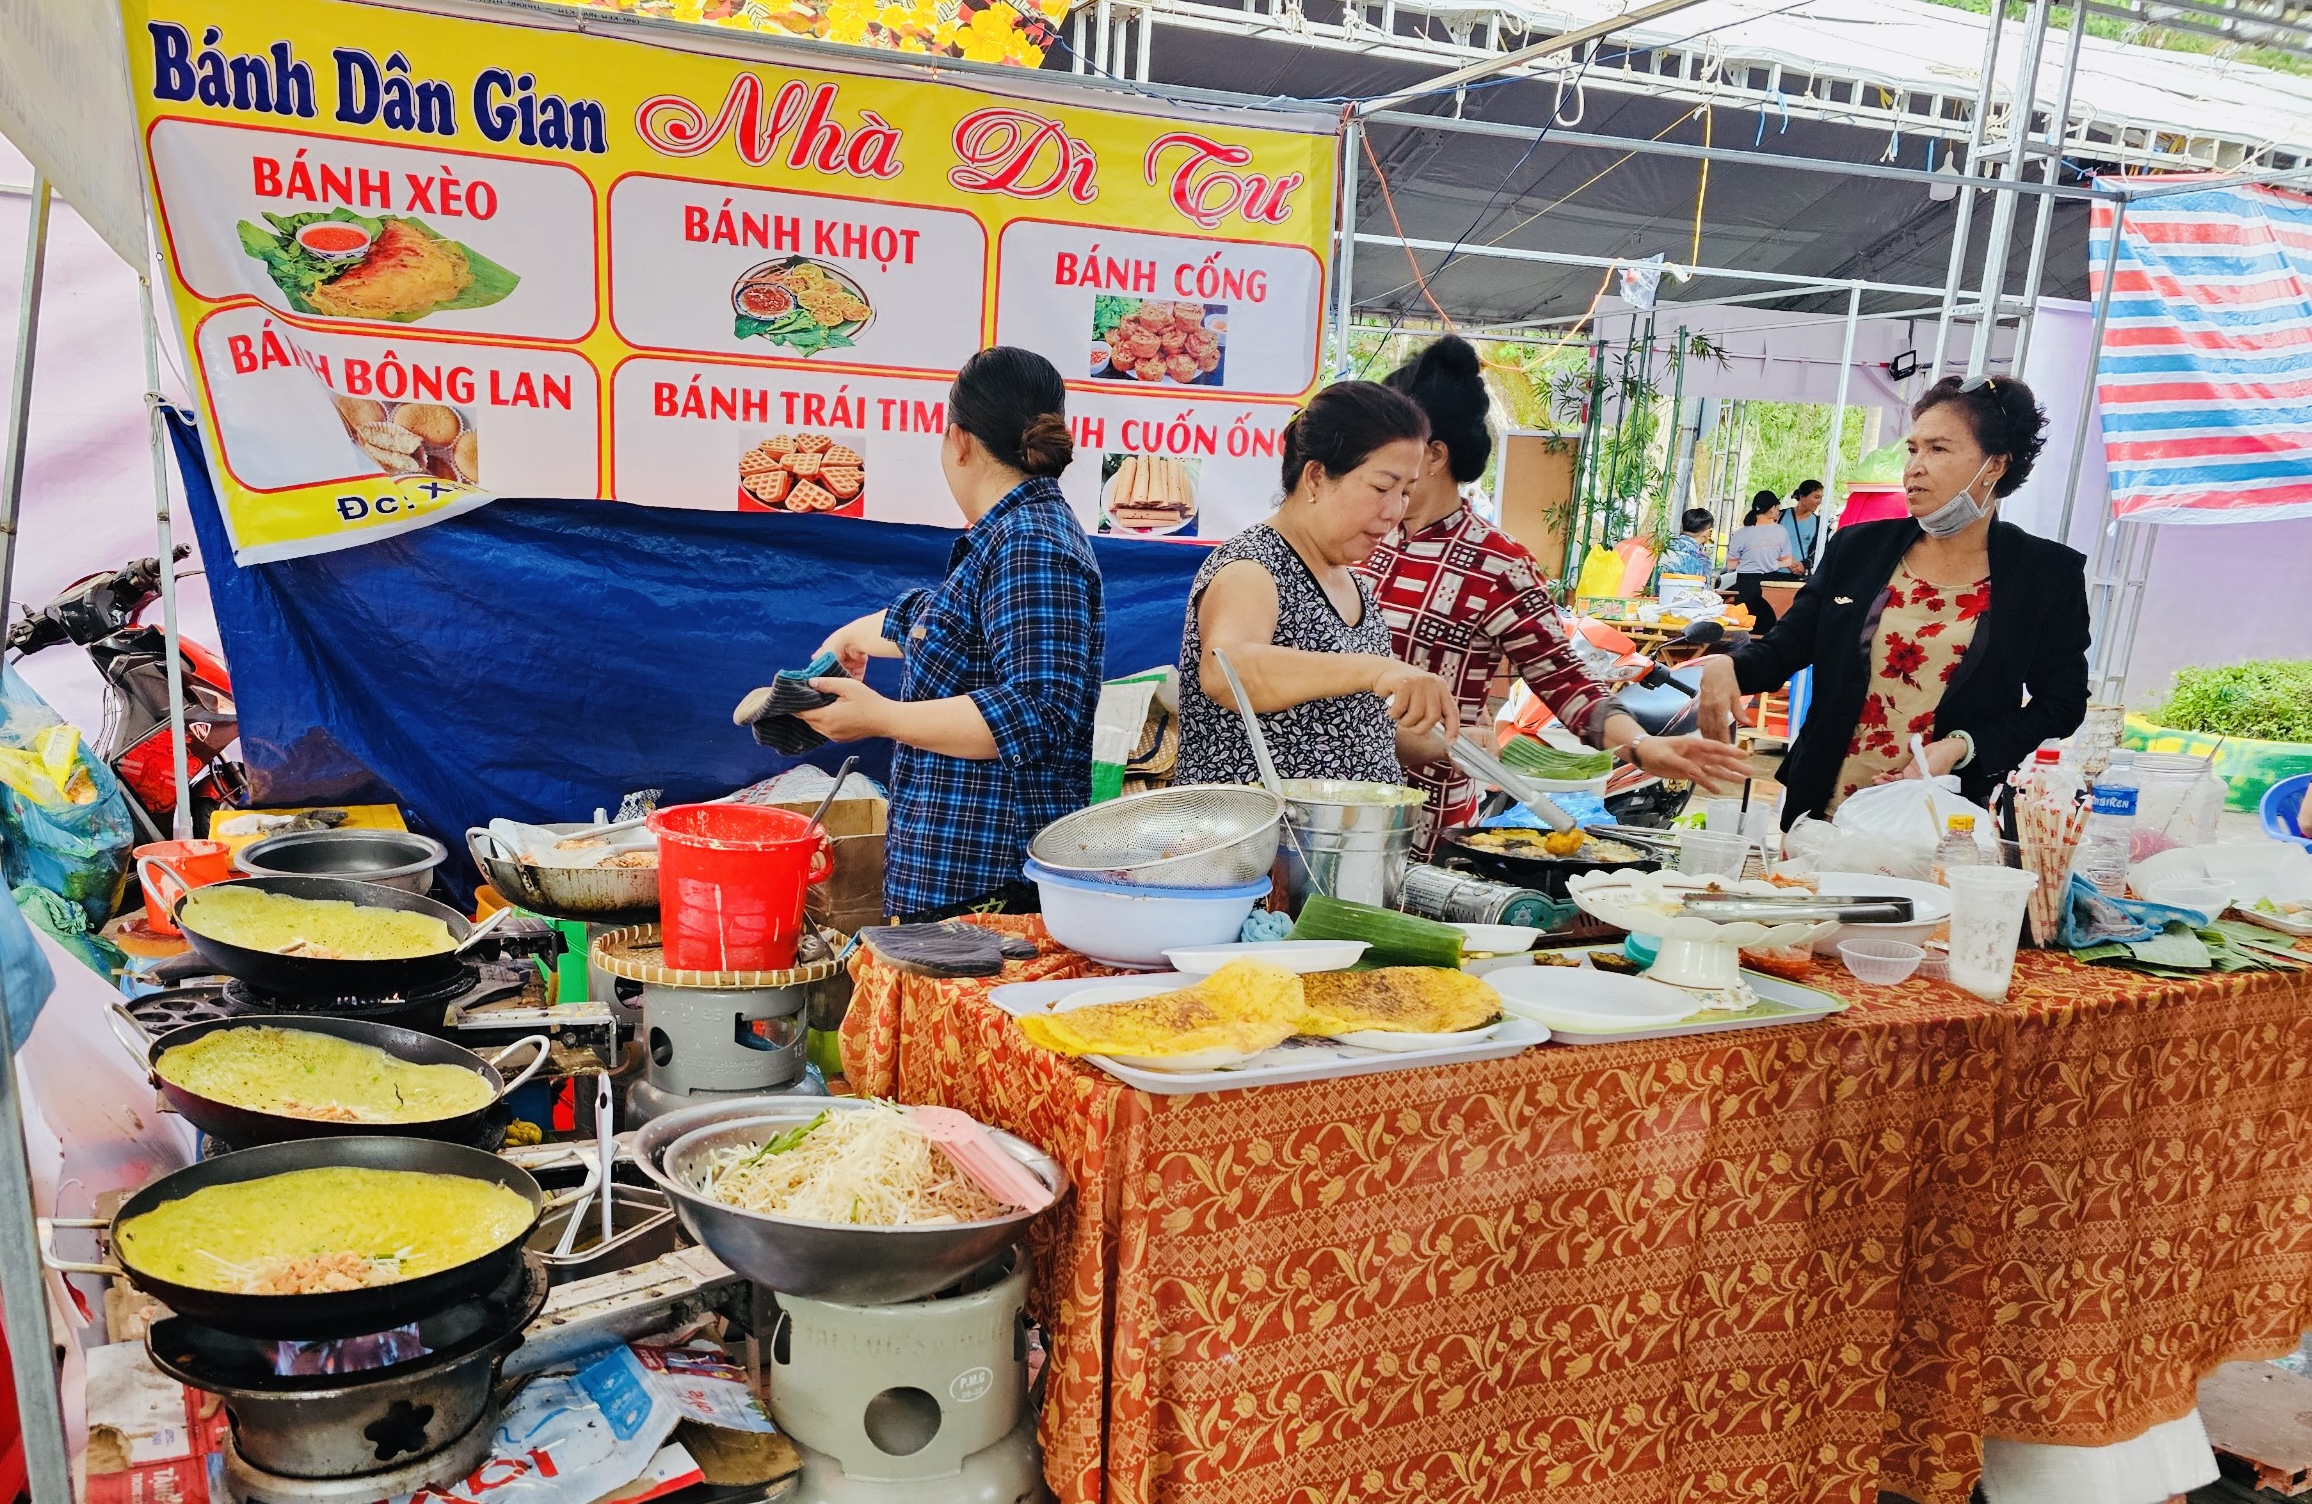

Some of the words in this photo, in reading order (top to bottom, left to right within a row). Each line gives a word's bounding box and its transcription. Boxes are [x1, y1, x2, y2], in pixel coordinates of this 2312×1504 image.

[148, 21, 316, 117] Bánh
[333, 48, 456, 135] Dân
[473, 69, 607, 153] Gian
[637, 72, 903, 177] Nhà
[948, 108, 1098, 204] Dì
[1143, 132, 1303, 229] Tư
[253, 148, 391, 209] BÁNH
[405, 166, 497, 220] XÈO
[685, 199, 800, 252] BÁNH
[815, 219, 920, 272] KHỌT
[1056, 251, 1156, 292] BÁNH
[1175, 252, 1267, 302] CỐNG
[345, 351, 475, 404] BÔNG
[490, 370, 571, 410] LAN
[654, 374, 768, 423] BÁNH
[780, 385, 865, 430] TRÁI
[878, 399, 944, 434] TIM
[1122, 409, 1217, 455] CUỐN
